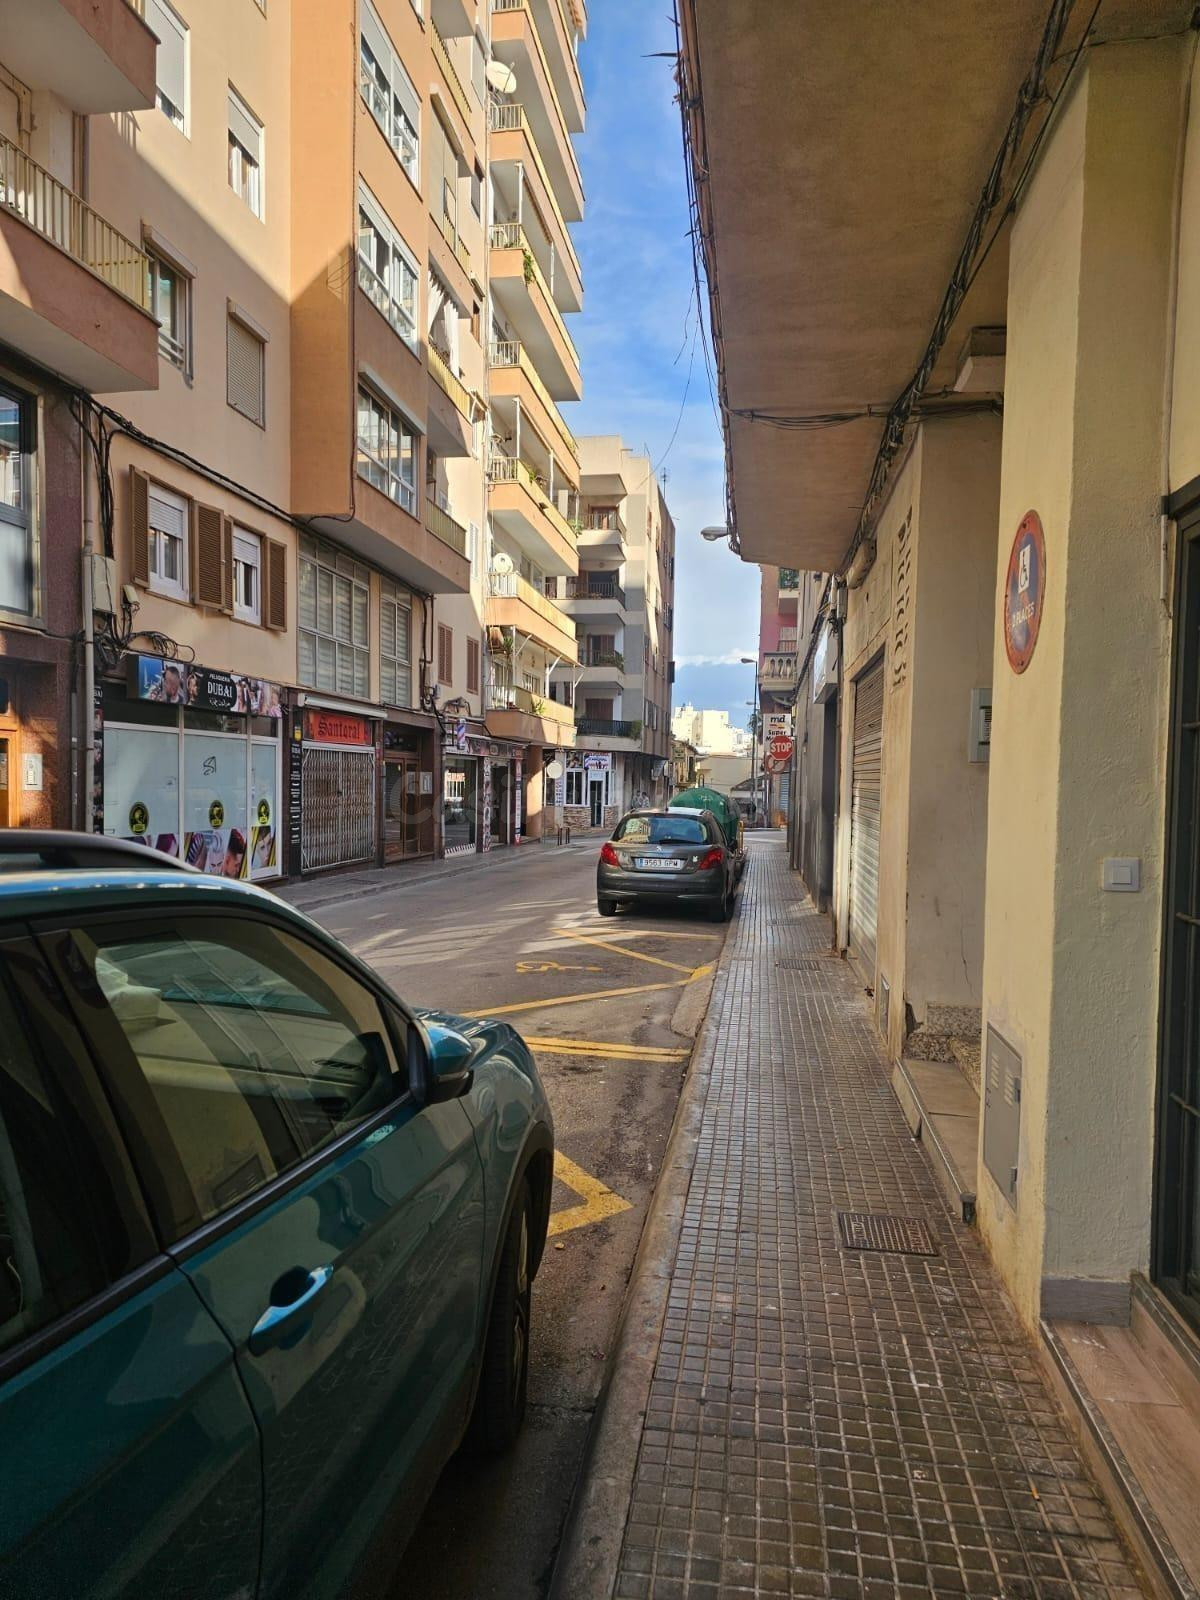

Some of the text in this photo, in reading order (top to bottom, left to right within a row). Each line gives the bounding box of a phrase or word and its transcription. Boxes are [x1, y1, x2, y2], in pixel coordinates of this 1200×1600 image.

[208, 682, 232, 698] DUBAI
[318, 714, 361, 740] Santoral
[771, 742, 792, 753] STOP
